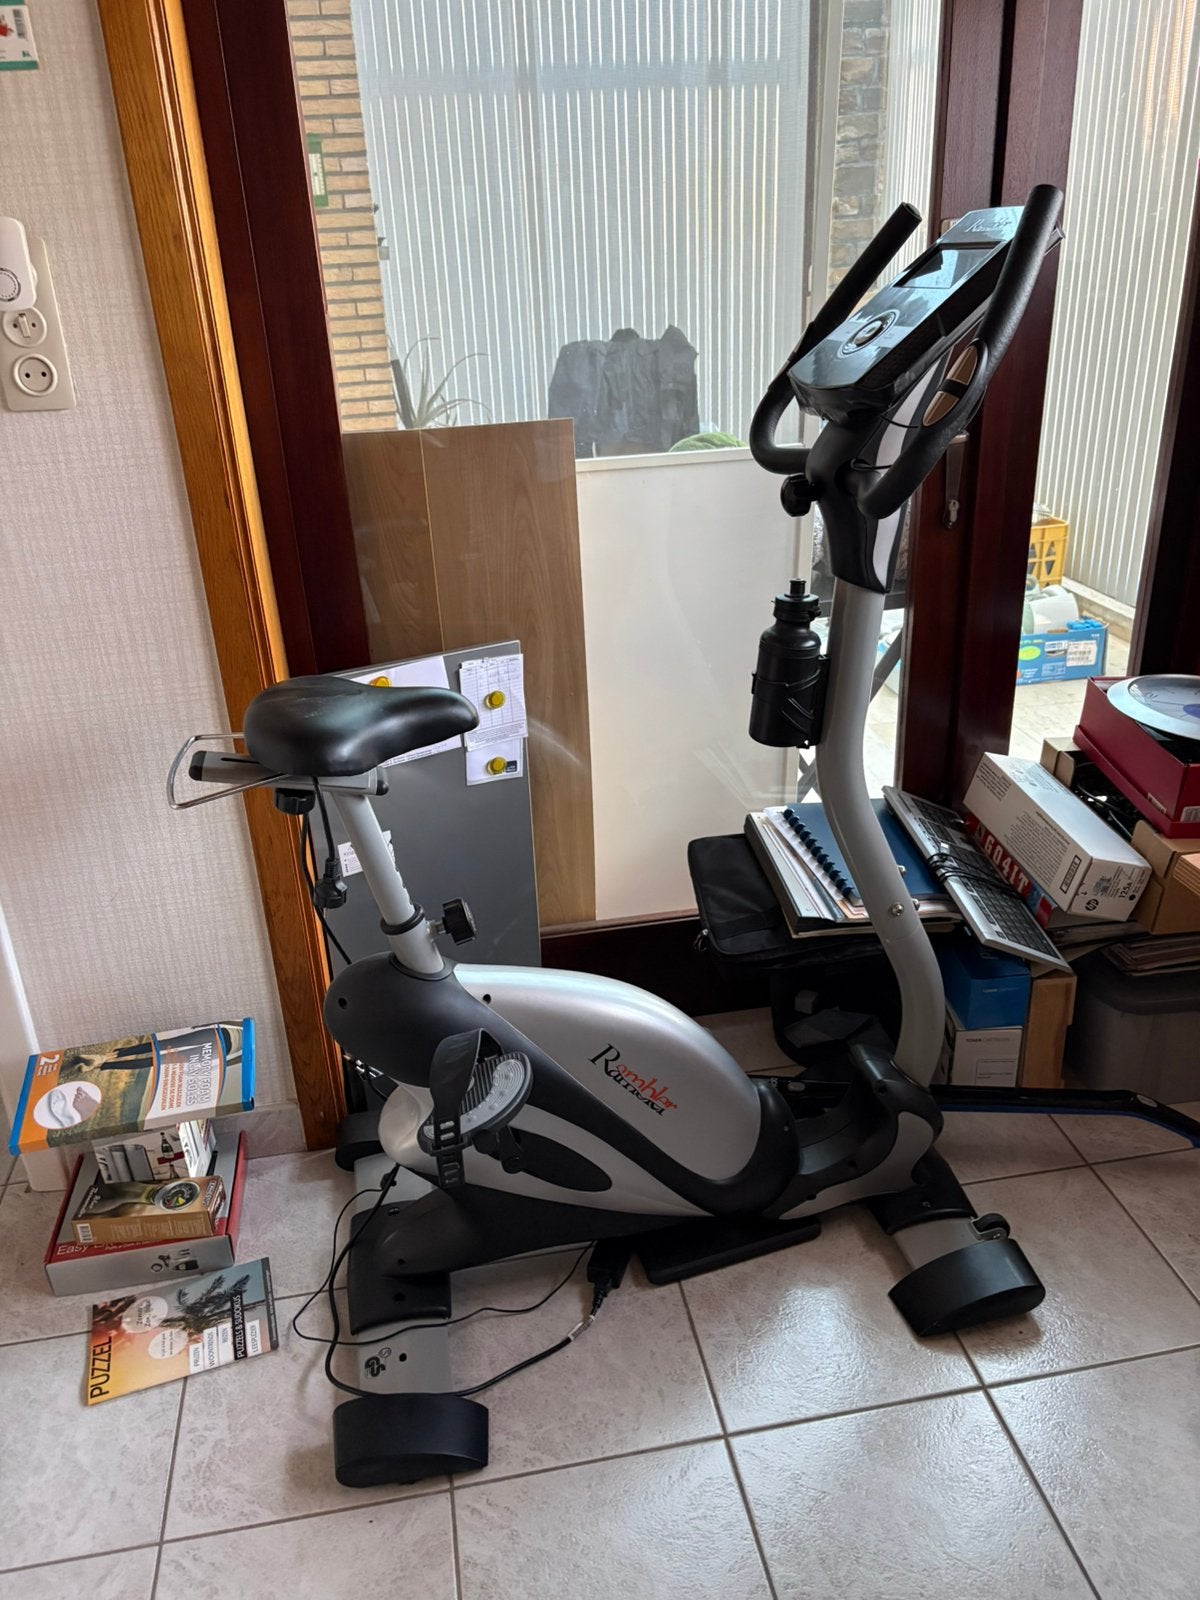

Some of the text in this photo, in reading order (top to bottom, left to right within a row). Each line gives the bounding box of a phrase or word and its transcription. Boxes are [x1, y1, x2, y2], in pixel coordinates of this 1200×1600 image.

[40, 1054, 60, 1066] 2
[200, 1042, 213, 1104] MEMORY FOAM
[187, 1054, 199, 1106] INLAY SOLES
[57, 1244, 88, 1256] Easy
[233, 1295, 243, 1324] SUDOKUS
[235, 1330, 245, 1358] PUZZELS
[90, 1336, 112, 1399] PUZZEL
